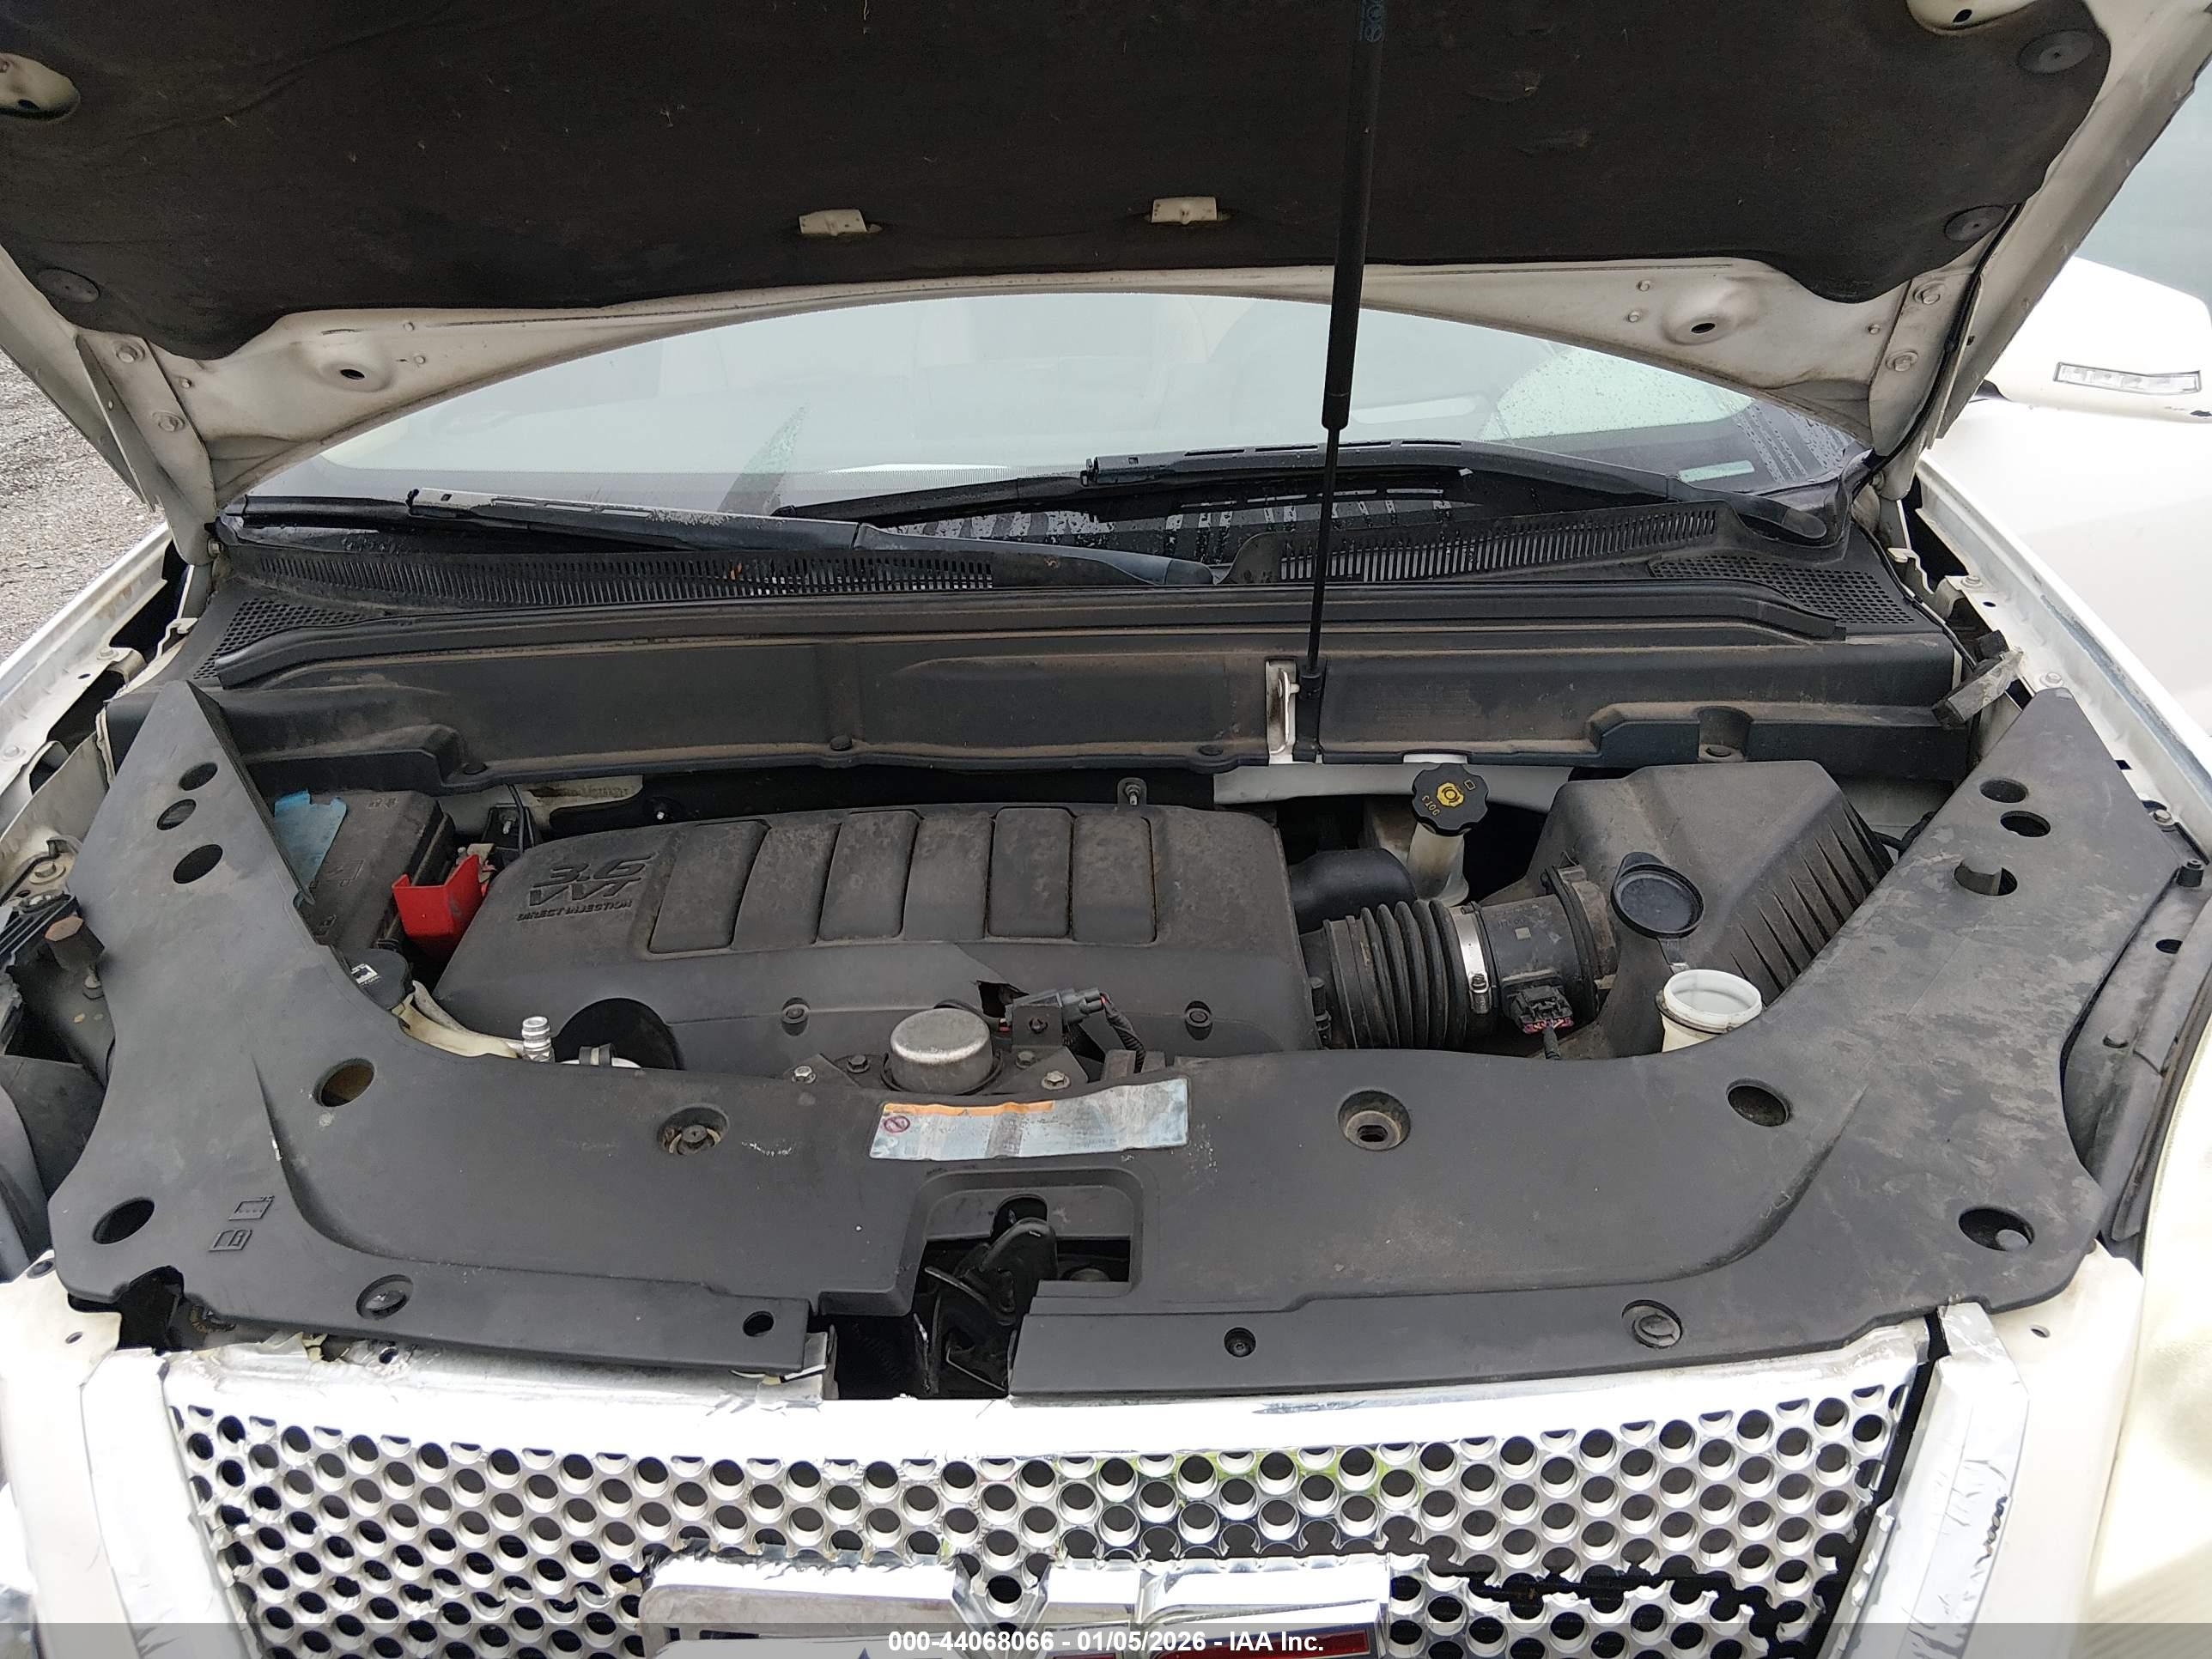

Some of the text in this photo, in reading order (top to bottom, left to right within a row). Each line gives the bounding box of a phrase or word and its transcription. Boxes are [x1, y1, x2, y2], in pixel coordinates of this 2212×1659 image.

[532, 851, 659, 889] 3.6
[528, 876, 642, 907] VVT
[516, 899, 634, 921] DIRECT INJECTION
